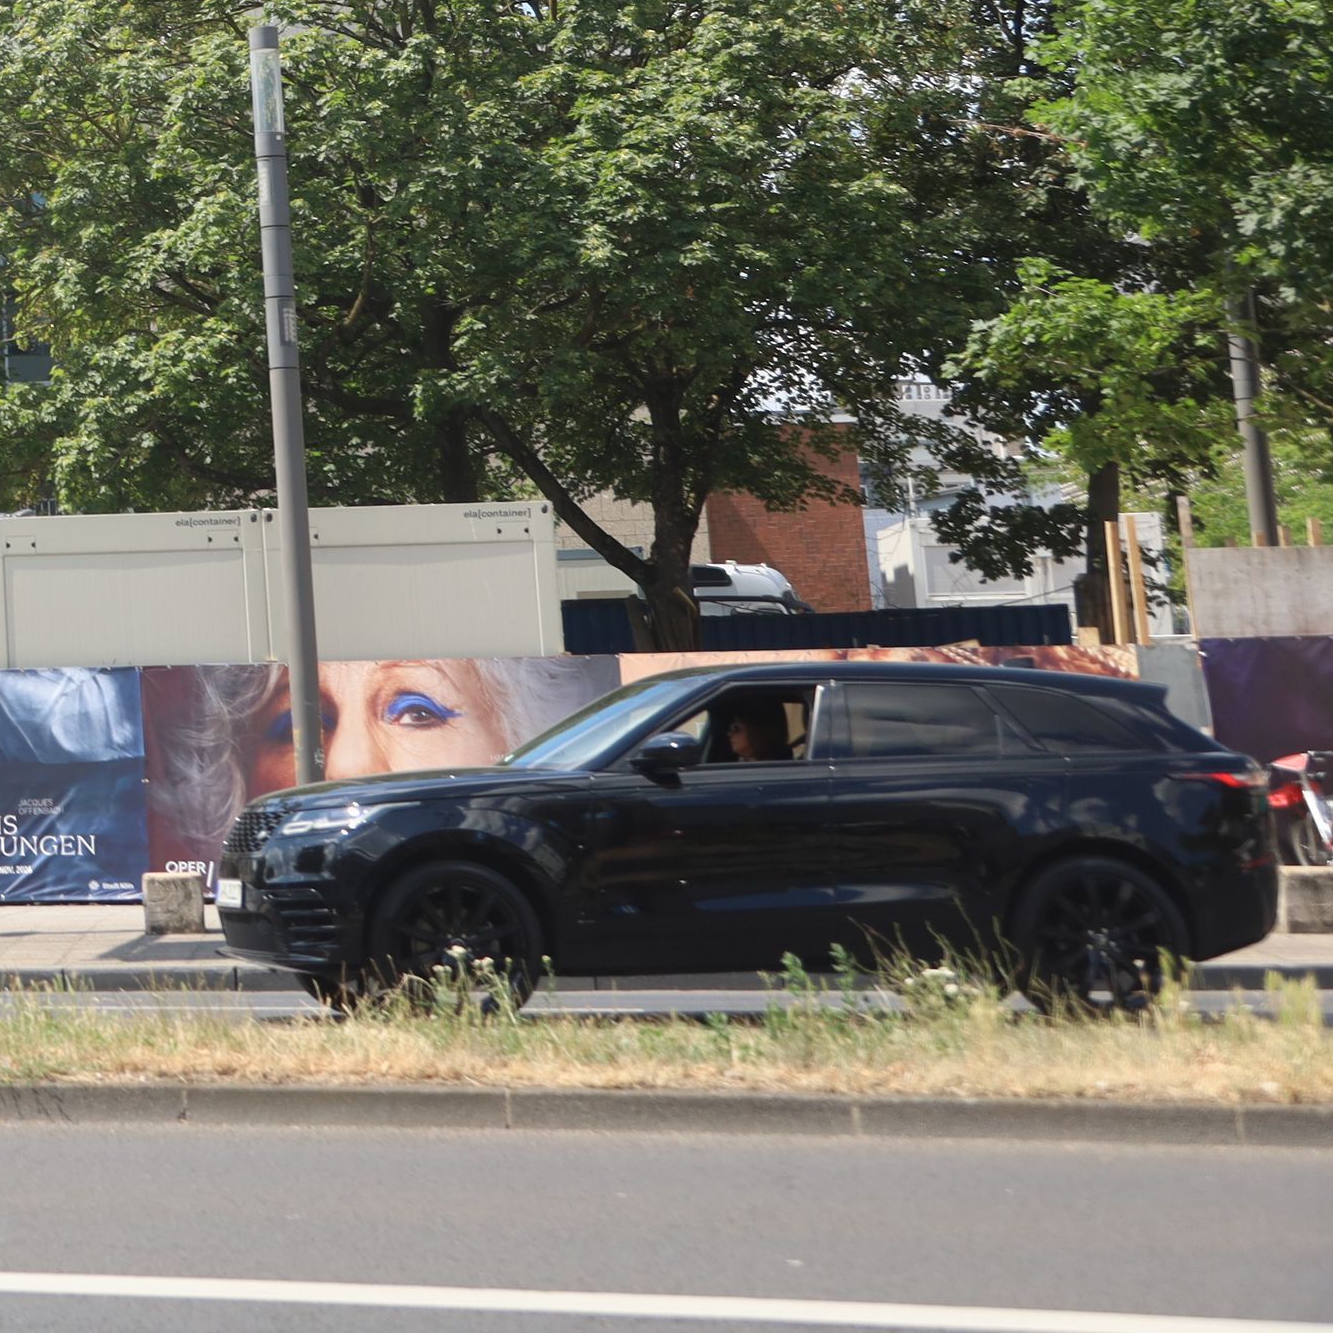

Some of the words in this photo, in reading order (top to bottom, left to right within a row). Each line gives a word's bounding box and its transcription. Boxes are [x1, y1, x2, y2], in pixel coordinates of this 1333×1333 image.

[463, 507, 532, 520] ela[container]
[175, 515, 241, 528] ela[container]
[164, 860, 207, 875] OPER
